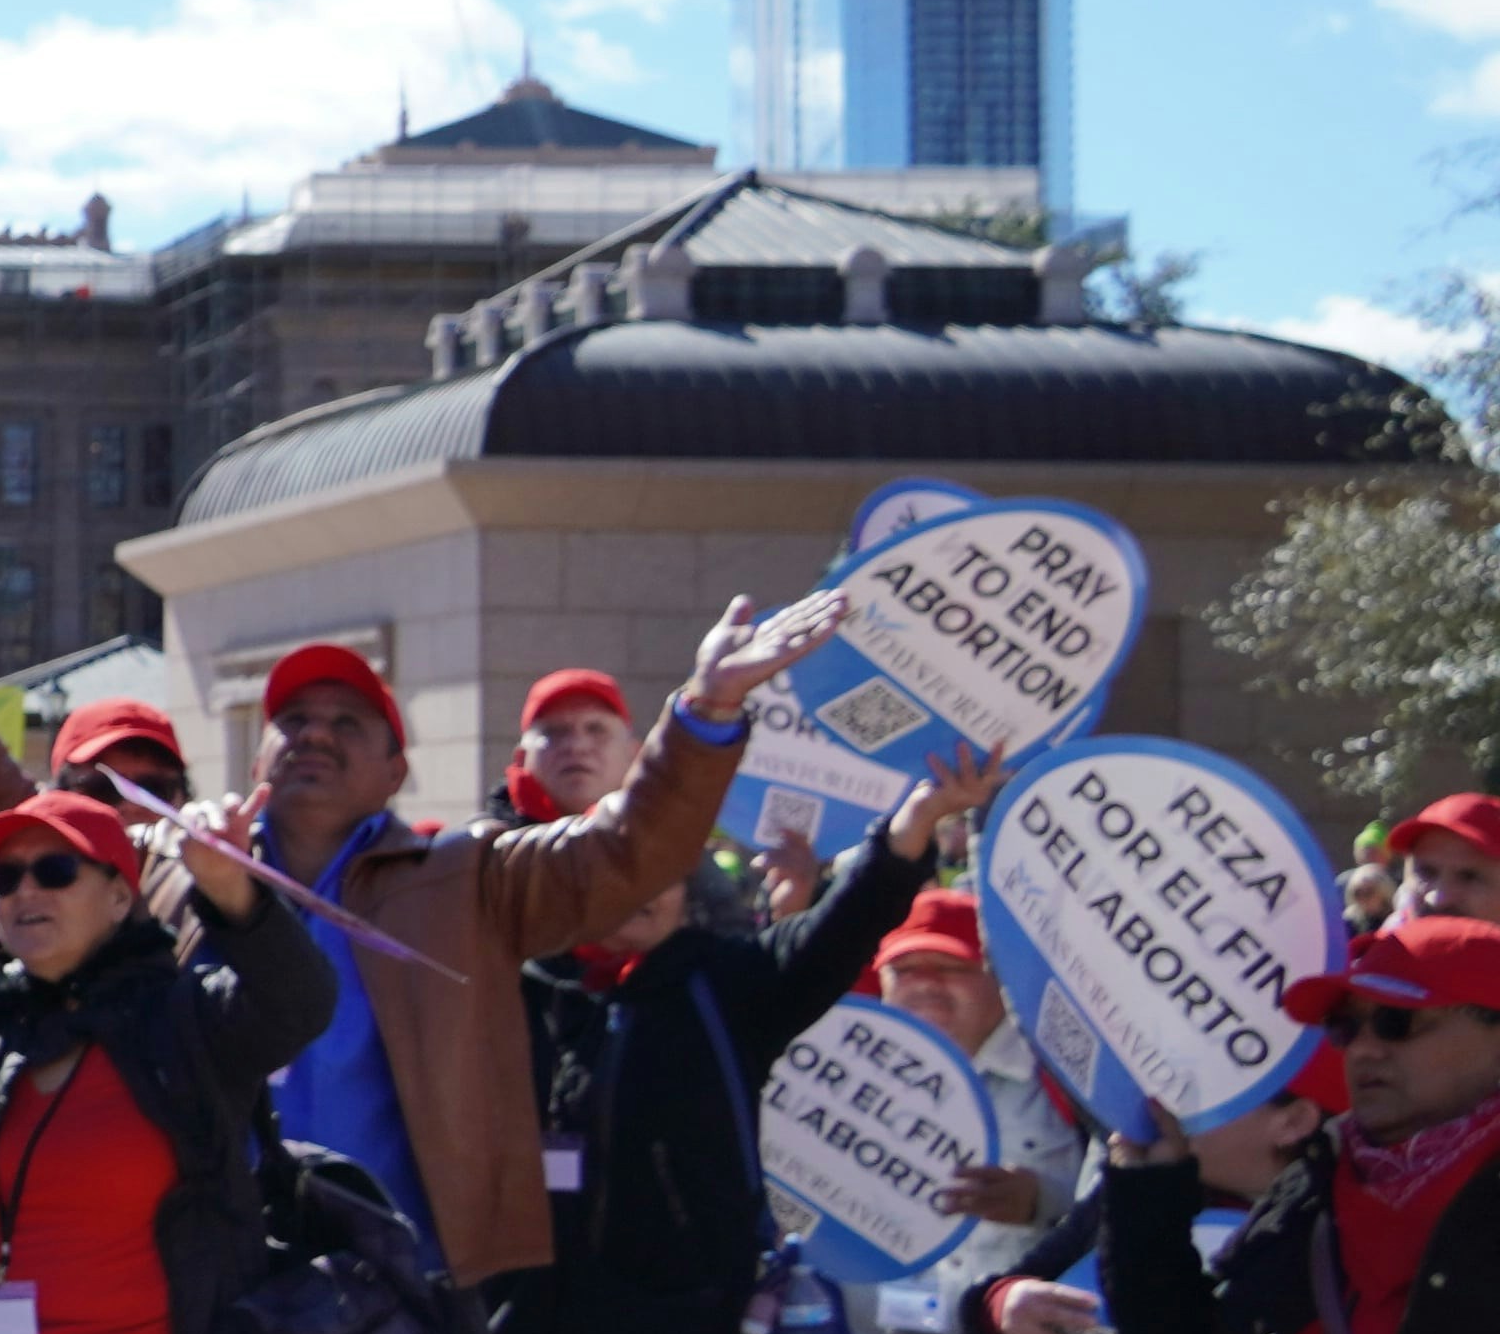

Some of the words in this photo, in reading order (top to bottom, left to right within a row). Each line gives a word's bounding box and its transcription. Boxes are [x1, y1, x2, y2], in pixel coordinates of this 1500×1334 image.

[950, 542, 1011, 599] TO
[1006, 589, 1092, 659] END
[1009, 524, 1119, 610] PRAY
[870, 561, 1079, 712] ABORTION
[1068, 770, 1163, 873] POR
[1159, 869, 1214, 935] EL
[1217, 927, 1288, 1011] FIN
[1166, 784, 1289, 914] REZA
[1018, 796, 1088, 893] DEL
[1087, 890, 1271, 1069] ABORTO
[787, 1042, 847, 1090] OR
[851, 1081, 895, 1128] EL
[905, 1117, 976, 1169] FIN
[841, 1020, 946, 1102] REZA
